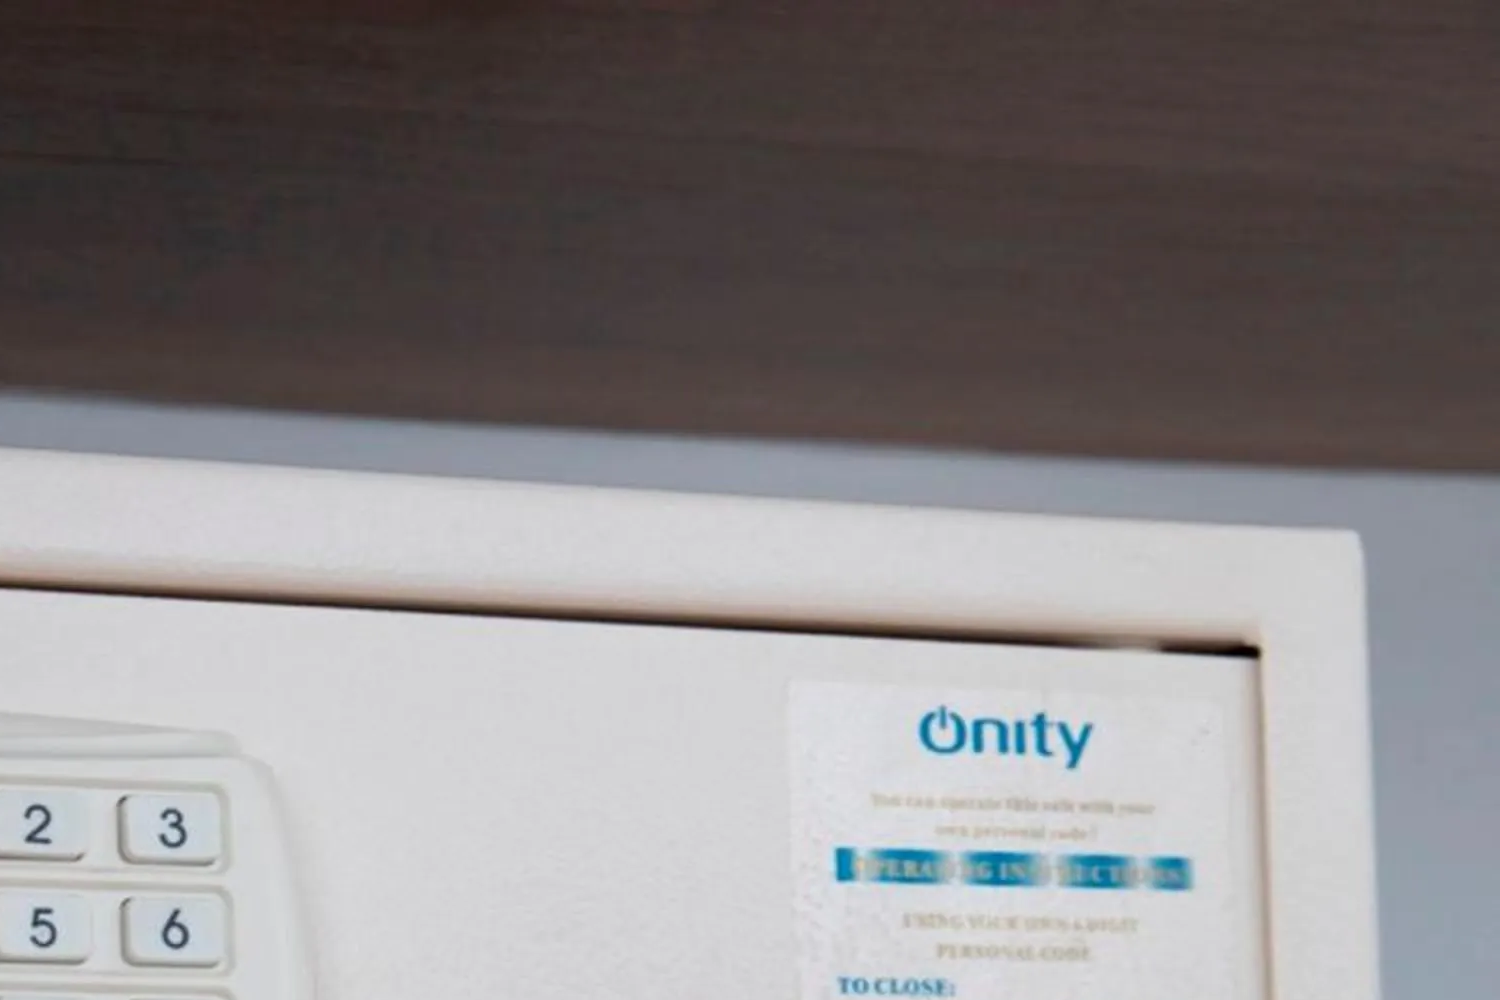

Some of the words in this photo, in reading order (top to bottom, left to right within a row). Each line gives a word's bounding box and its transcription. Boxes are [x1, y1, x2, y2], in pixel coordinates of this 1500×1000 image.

[918, 705, 1094, 769] Onity
[23, 803, 52, 844] 2
[158, 807, 188, 848] 3
[29, 907, 57, 948] 5
[161, 908, 190, 949] 6
[838, 976, 870, 996] TO
[873, 977, 957, 998] CLOSE:
